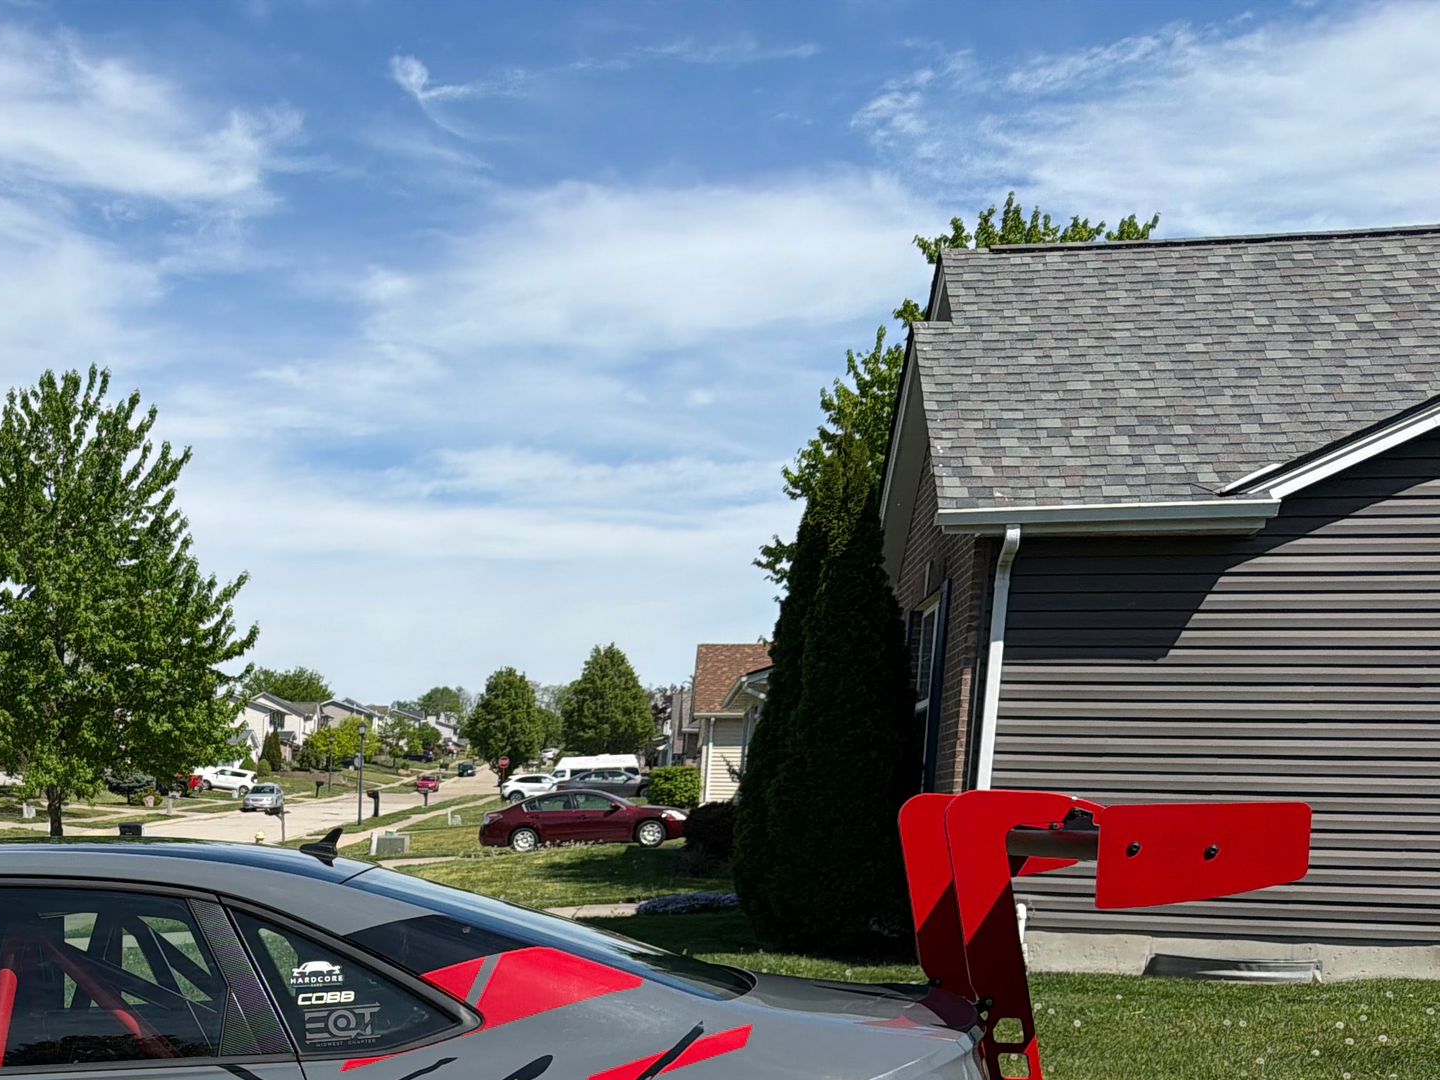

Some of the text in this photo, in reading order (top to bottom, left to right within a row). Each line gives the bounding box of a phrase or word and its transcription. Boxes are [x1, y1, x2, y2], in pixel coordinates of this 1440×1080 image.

[290, 975, 343, 984] HARDCORE
[297, 991, 355, 1005] COBB
[303, 1005, 380, 1041] EQT
